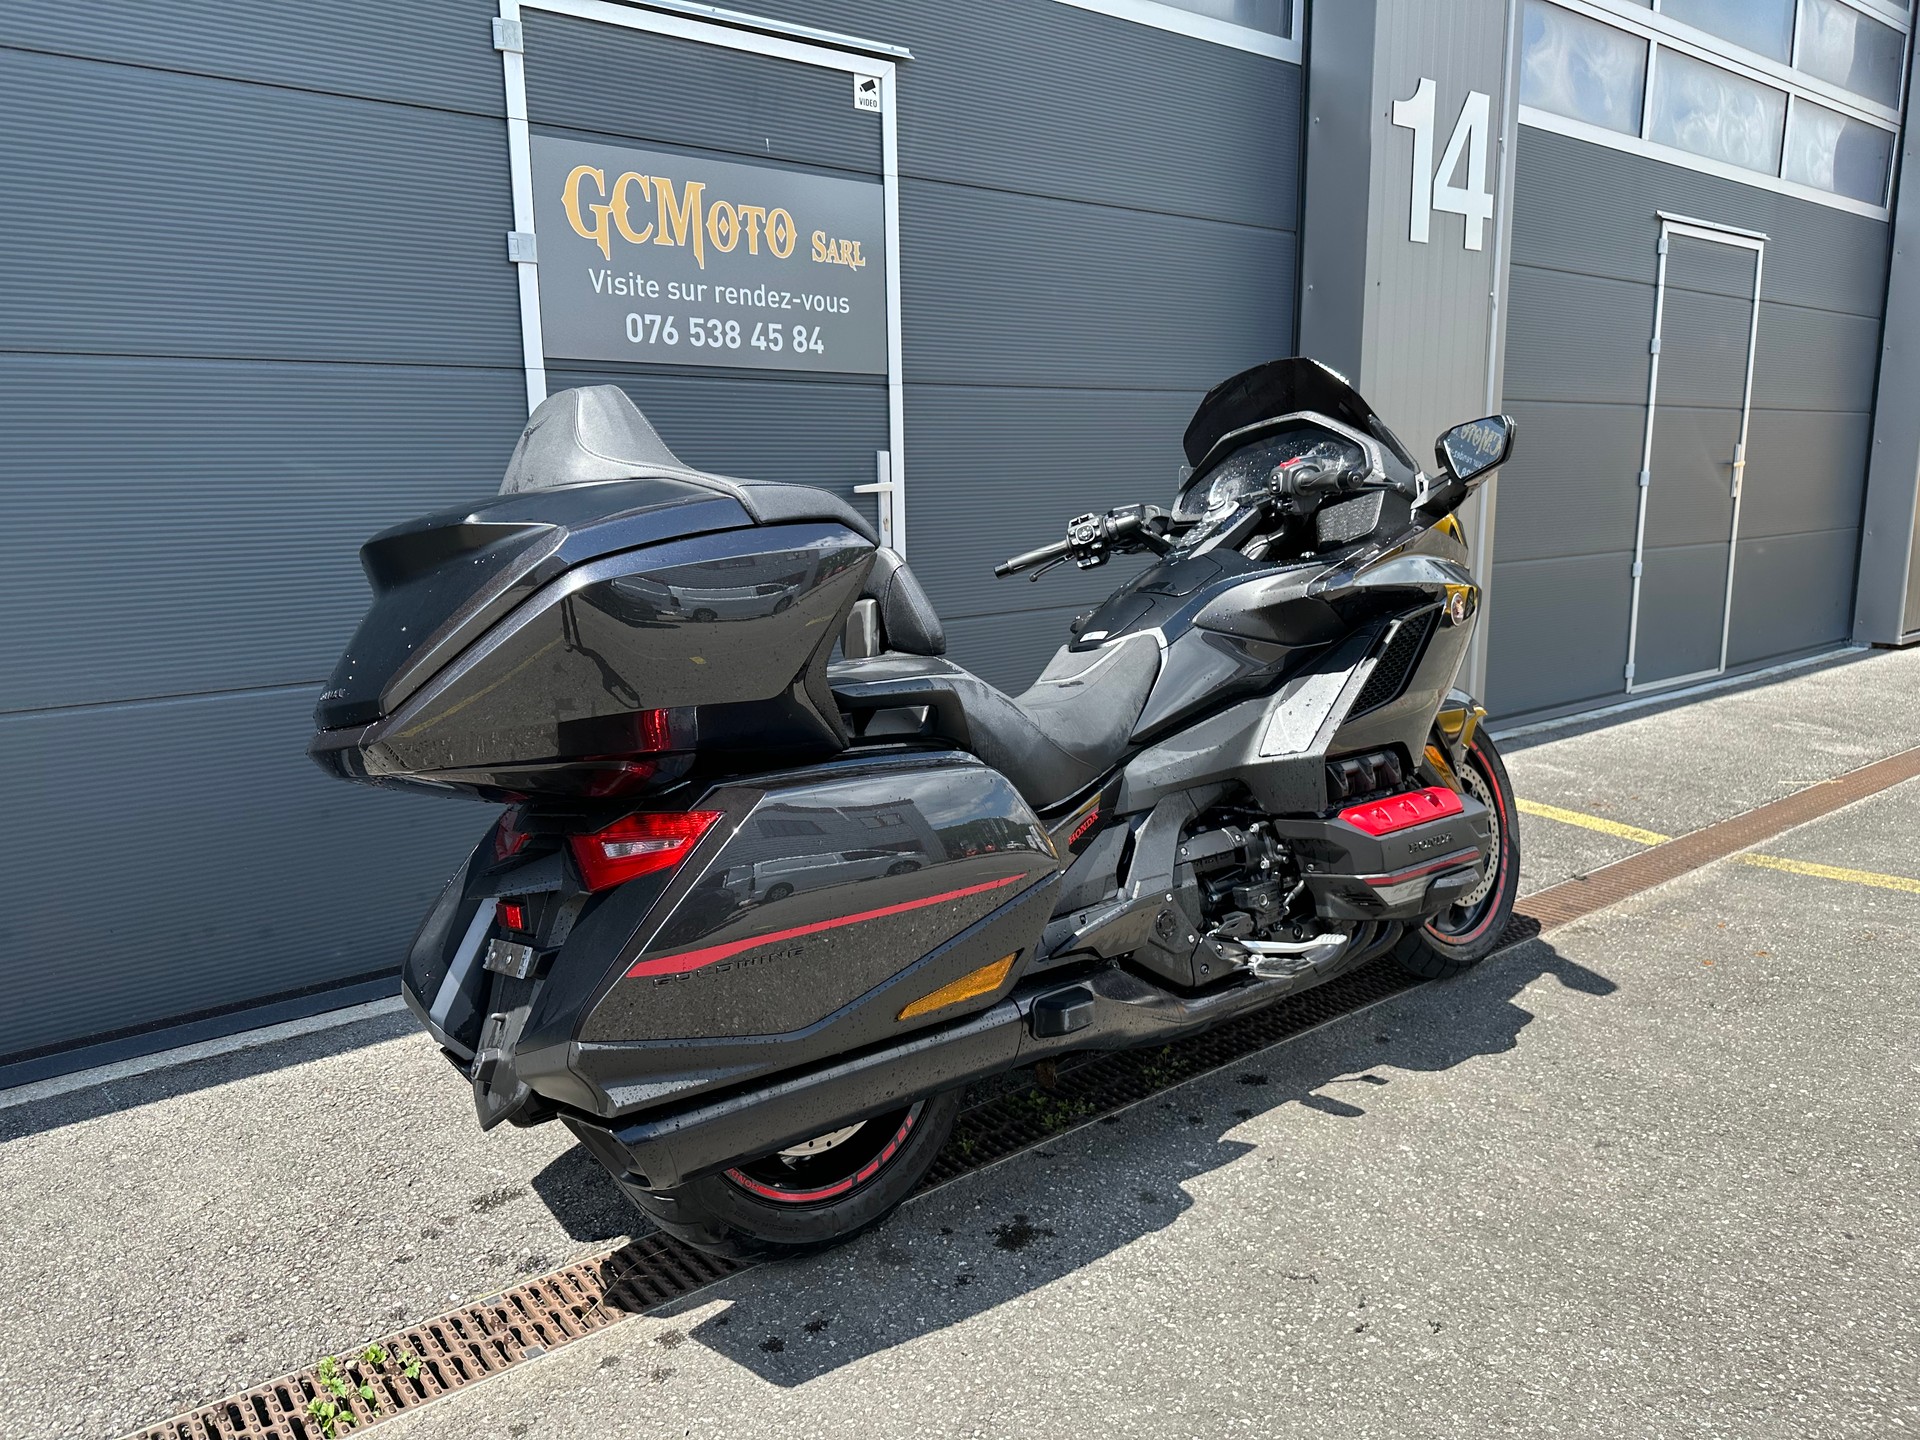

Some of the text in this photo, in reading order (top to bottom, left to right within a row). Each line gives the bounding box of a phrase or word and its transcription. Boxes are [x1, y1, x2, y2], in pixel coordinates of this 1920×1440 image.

[858, 97, 878, 108] VIDEO
[1392, 77, 1494, 251] 14
[588, 268, 850, 314] Visite sur rendez-vous
[625, 312, 825, 354] 076 538 45 84
[1068, 812, 1099, 845] HONDA
[1408, 832, 1453, 854] HONDA
